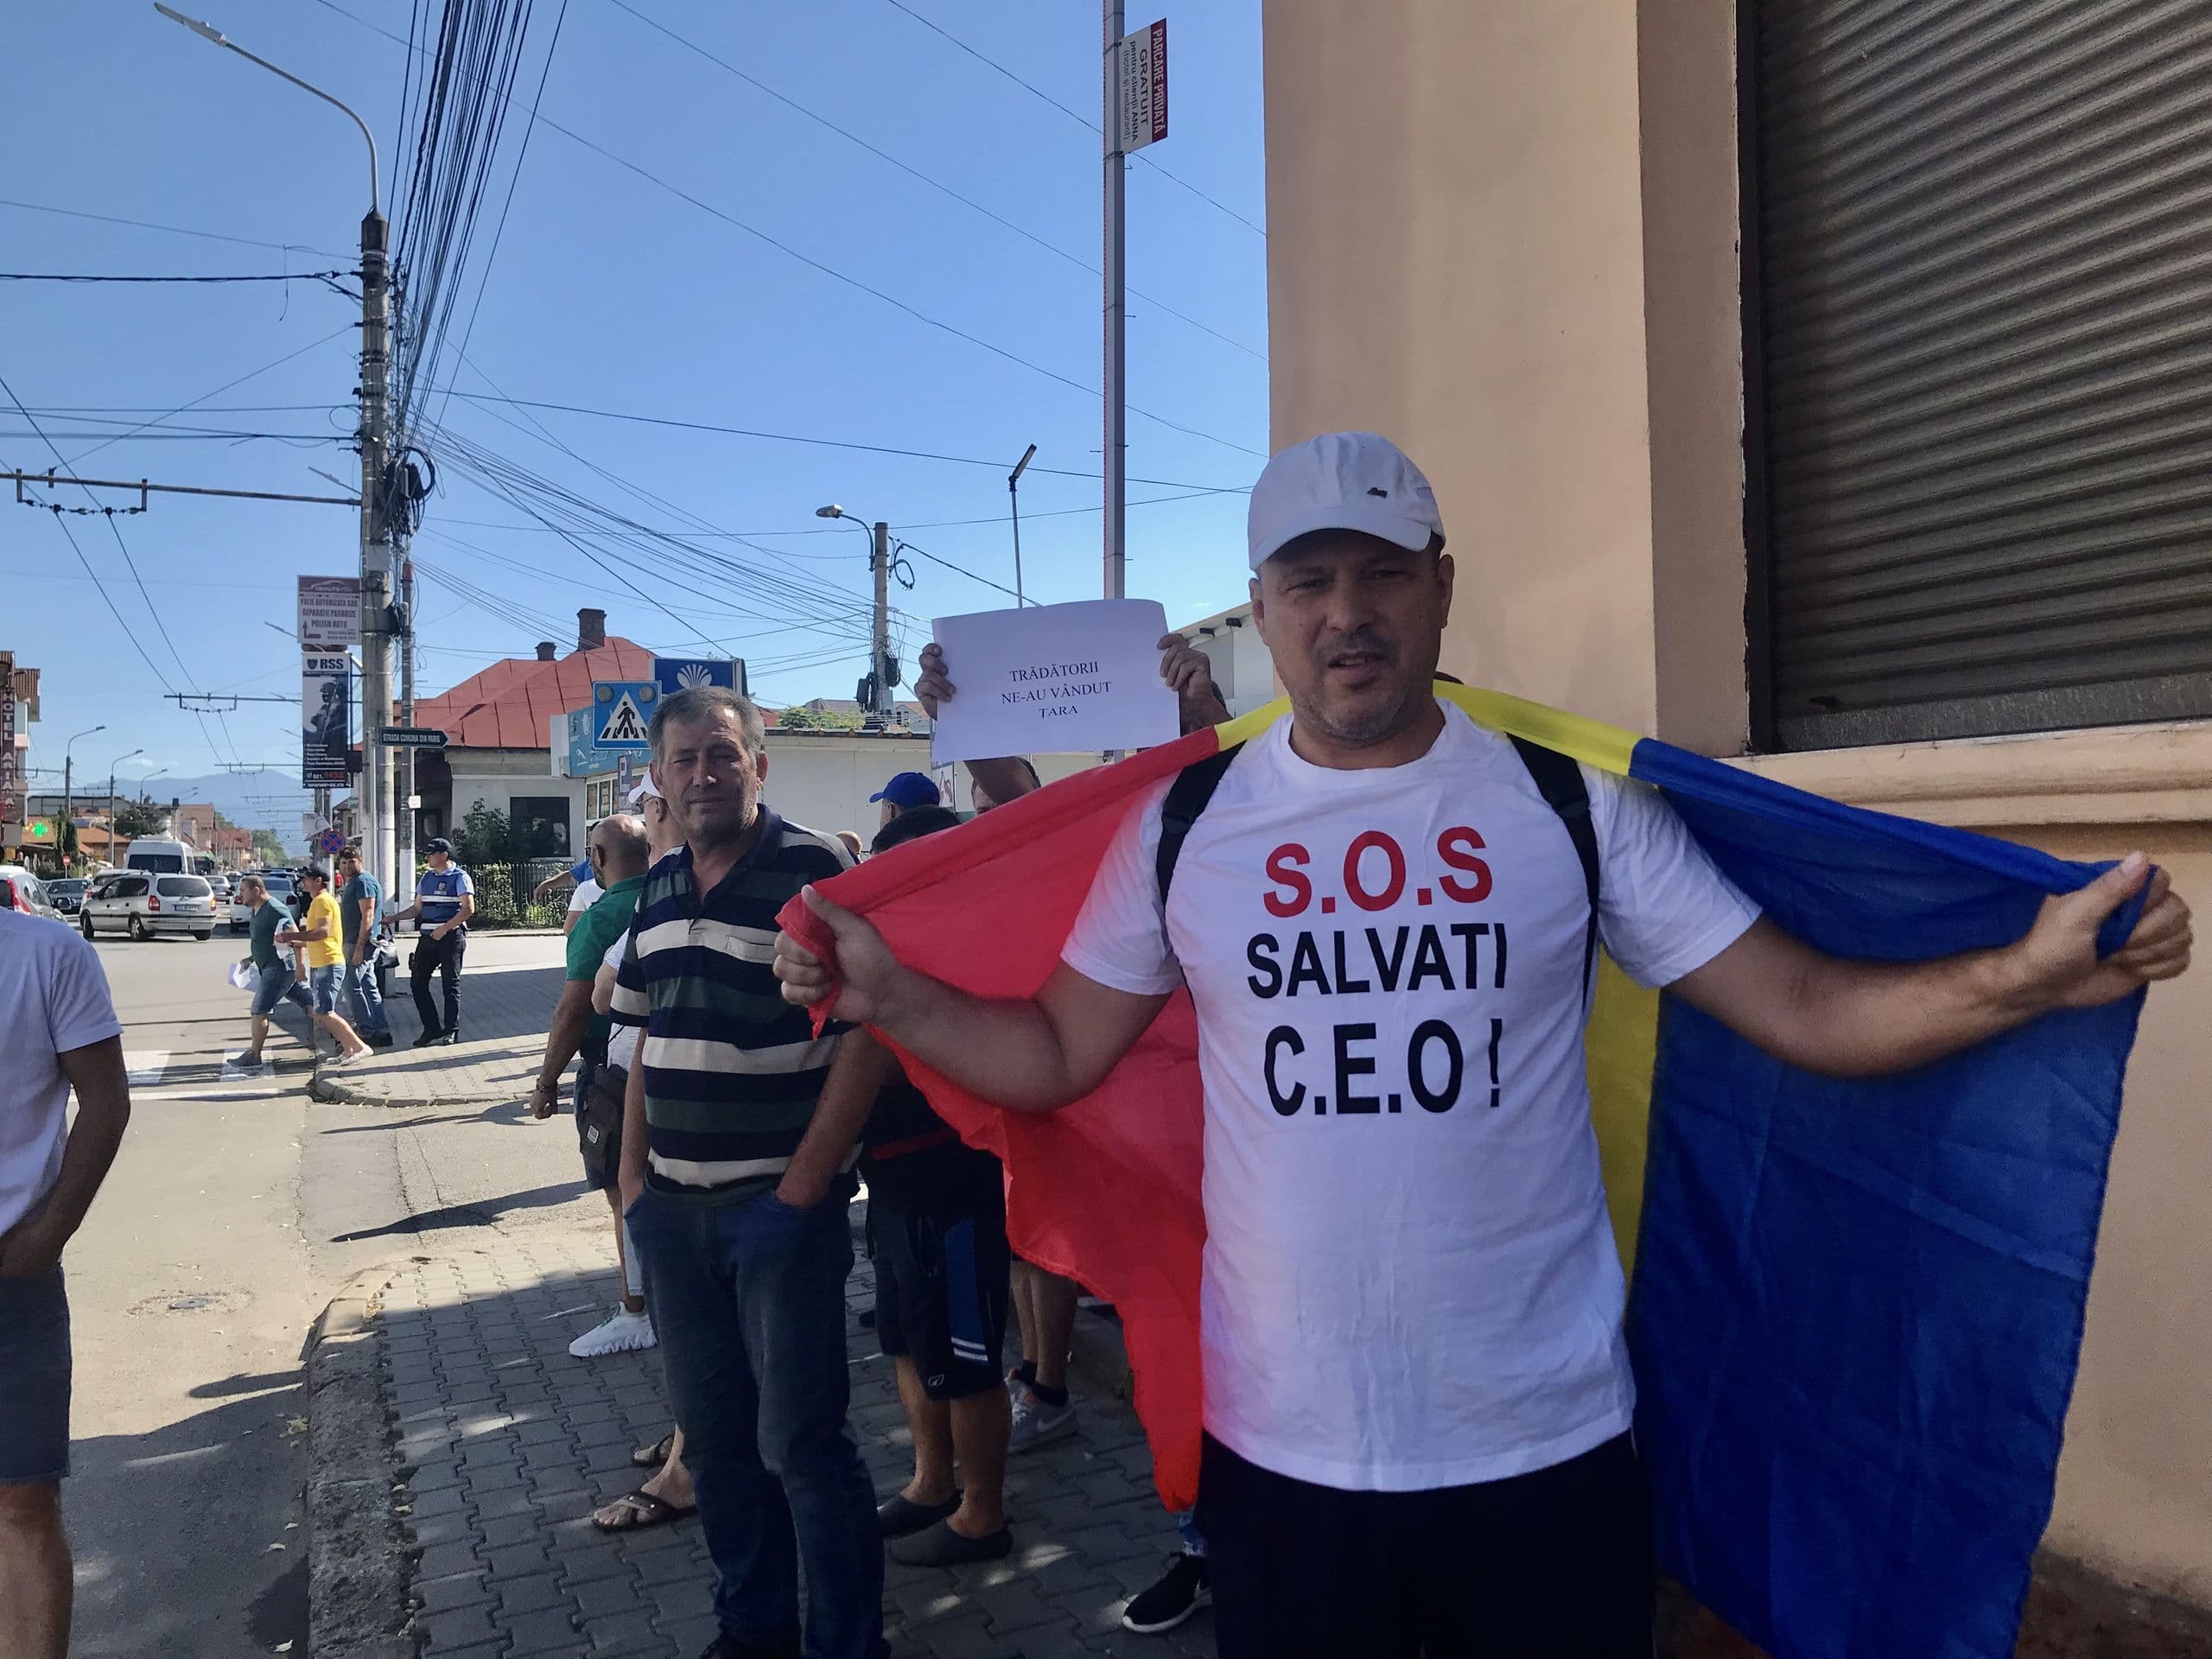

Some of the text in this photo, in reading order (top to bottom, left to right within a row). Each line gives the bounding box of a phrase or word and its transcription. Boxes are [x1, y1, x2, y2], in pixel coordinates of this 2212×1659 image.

[1140, 48, 1148, 125] GRATUIT
[1153, 29, 1166, 134] PARCARE PRIVATĂ
[333, 620, 347, 628] AUTO
[320, 658, 344, 670] RSS
[1009, 661, 1099, 683] TRĂDĂTORII
[1001, 682, 1112, 704] NE-AU VÂNDUT
[3, 693, 14, 741] HOTEL
[428, 734, 441, 743] PARIS
[1263, 826, 1492, 918] S.O.S
[1247, 923, 1507, 999] SALVATI
